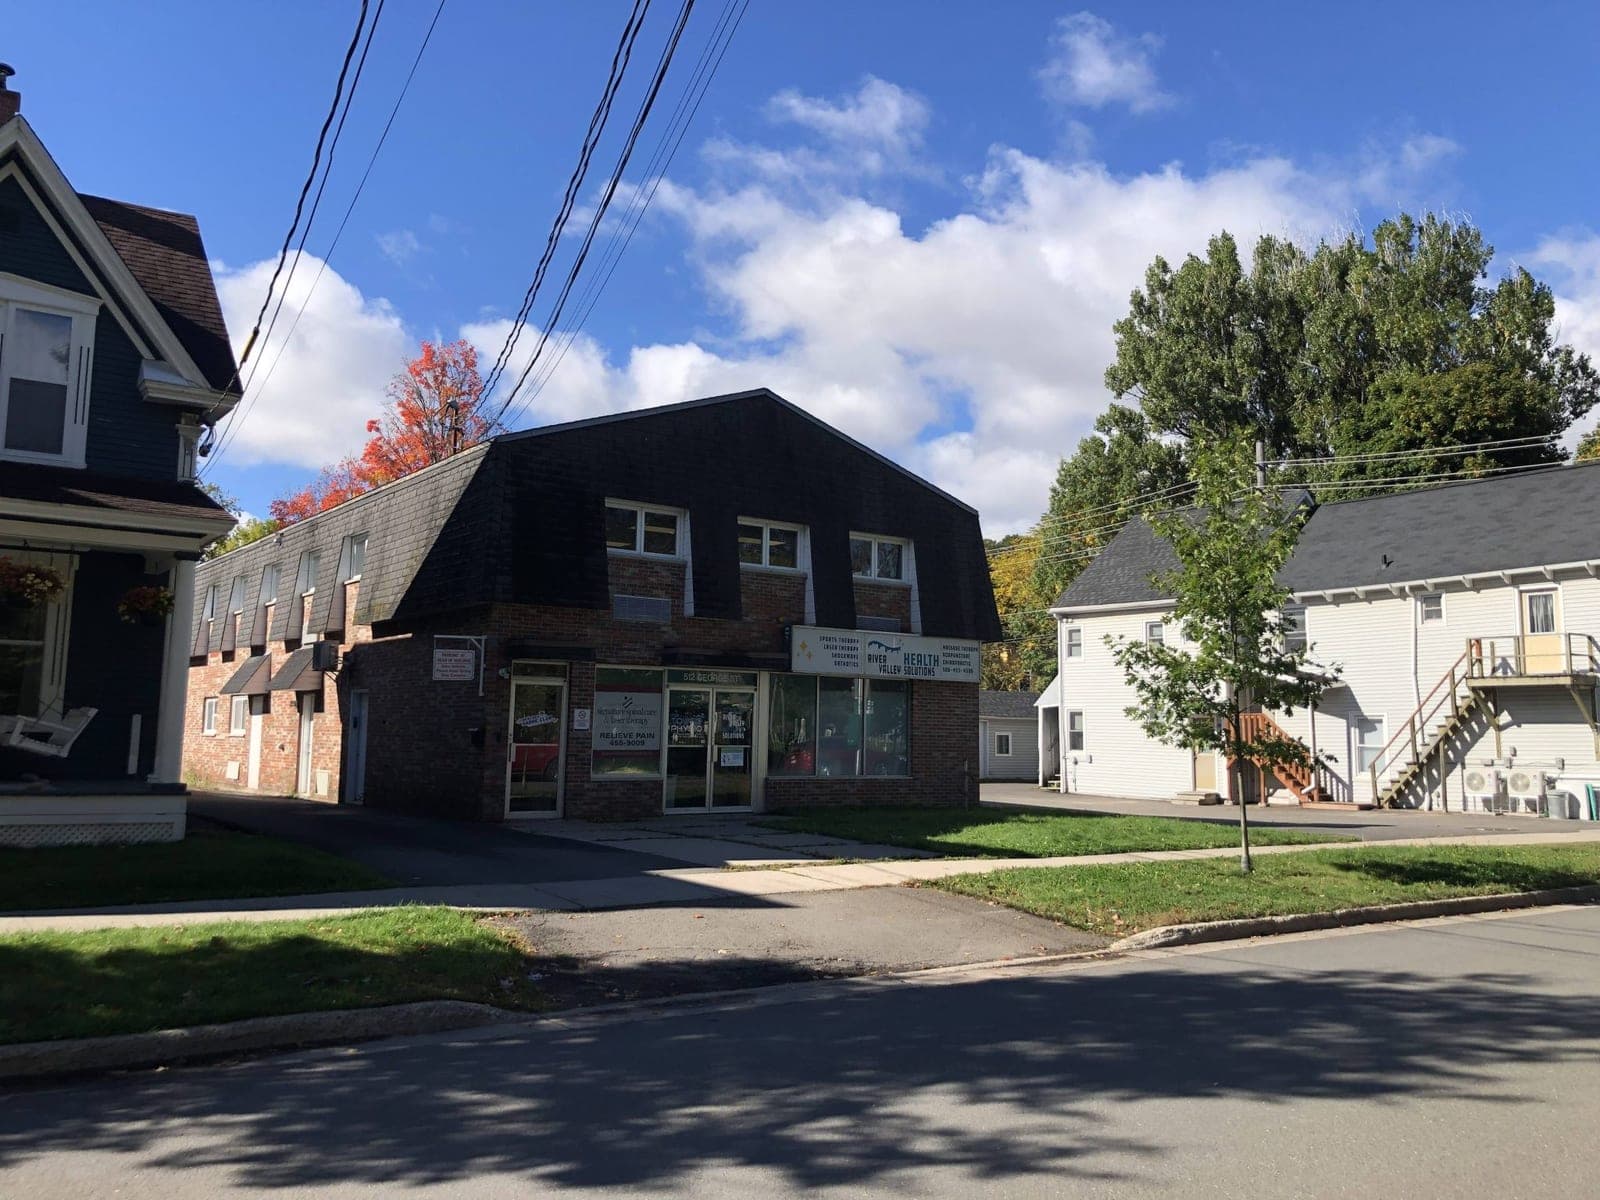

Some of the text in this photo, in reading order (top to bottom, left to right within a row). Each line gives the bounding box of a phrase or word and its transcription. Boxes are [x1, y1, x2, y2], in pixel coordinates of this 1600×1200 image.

[867, 654, 887, 664] RIVER
[903, 653, 940, 667] HEALTH
[879, 664, 901, 674] VALLEY
[903, 666, 936, 676] SOLUTIONS
[683, 672, 696, 681] 512
